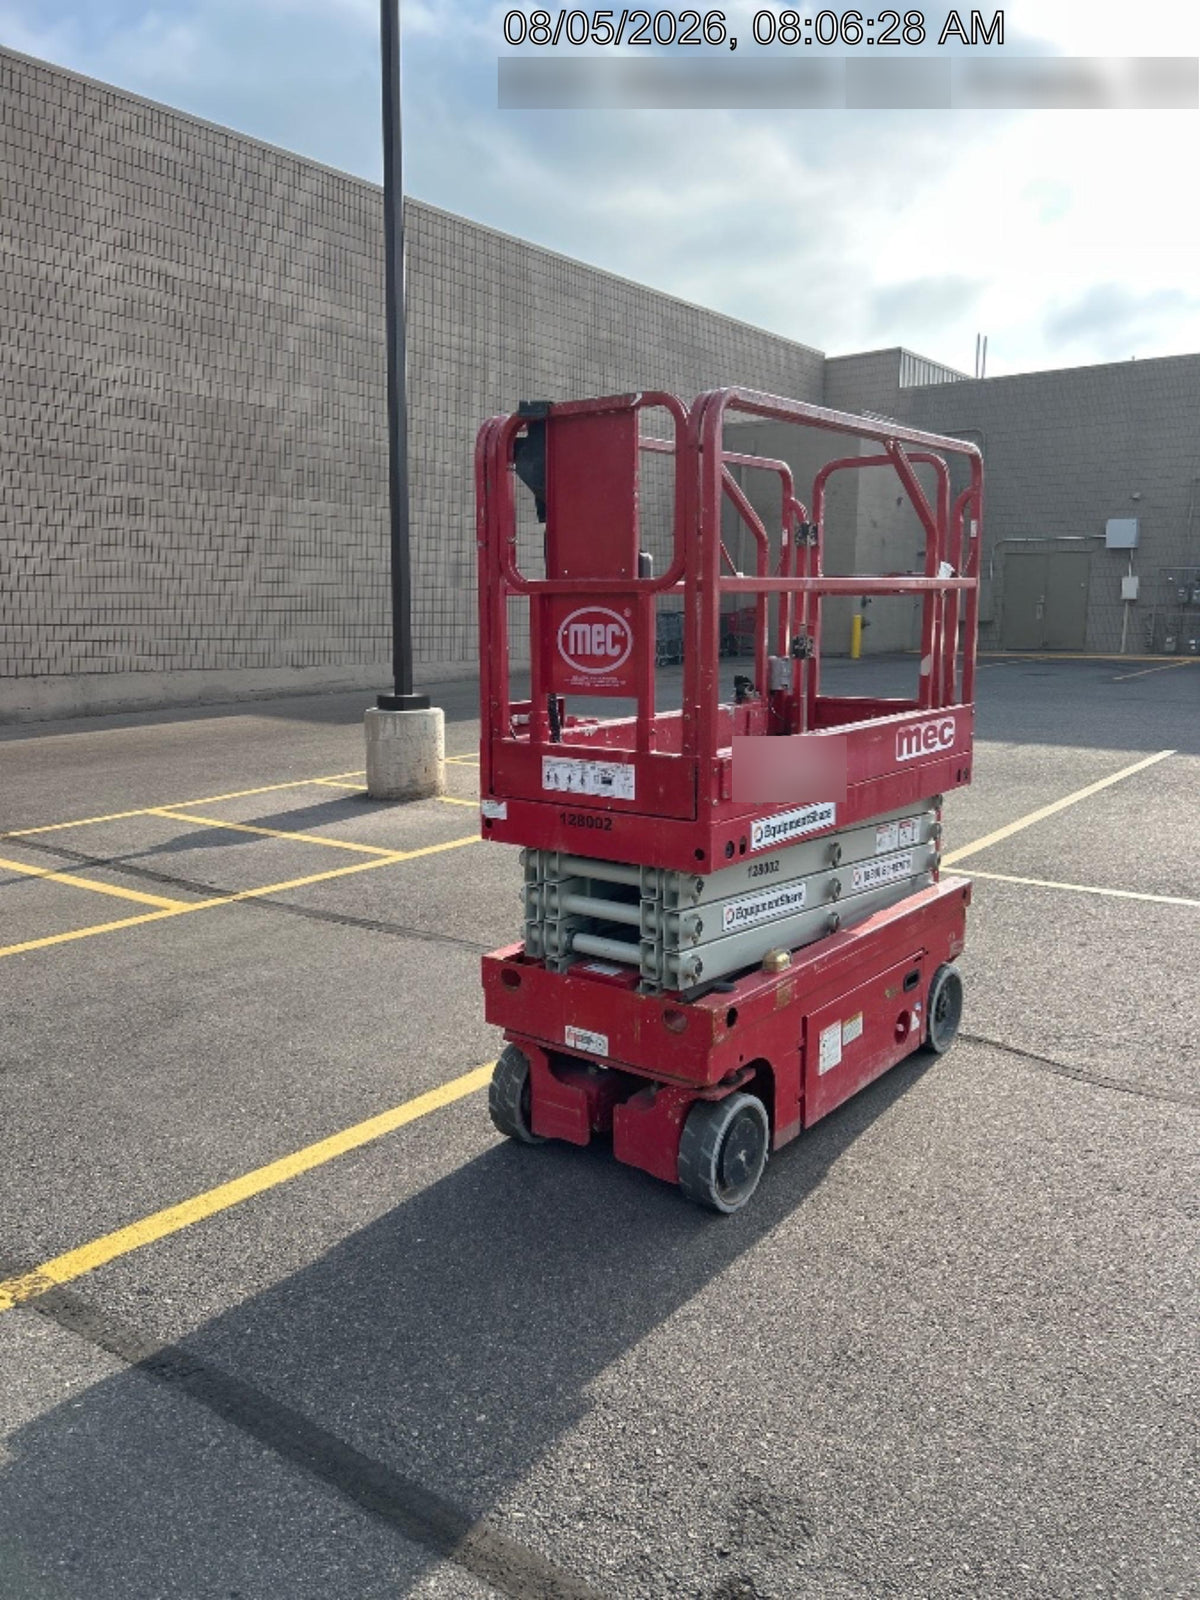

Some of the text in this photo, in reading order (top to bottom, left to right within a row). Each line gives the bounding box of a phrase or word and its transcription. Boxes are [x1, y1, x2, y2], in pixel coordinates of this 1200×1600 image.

[569, 623, 621, 656] mec
[897, 721, 954, 758] mec
[560, 812, 613, 831] 128002
